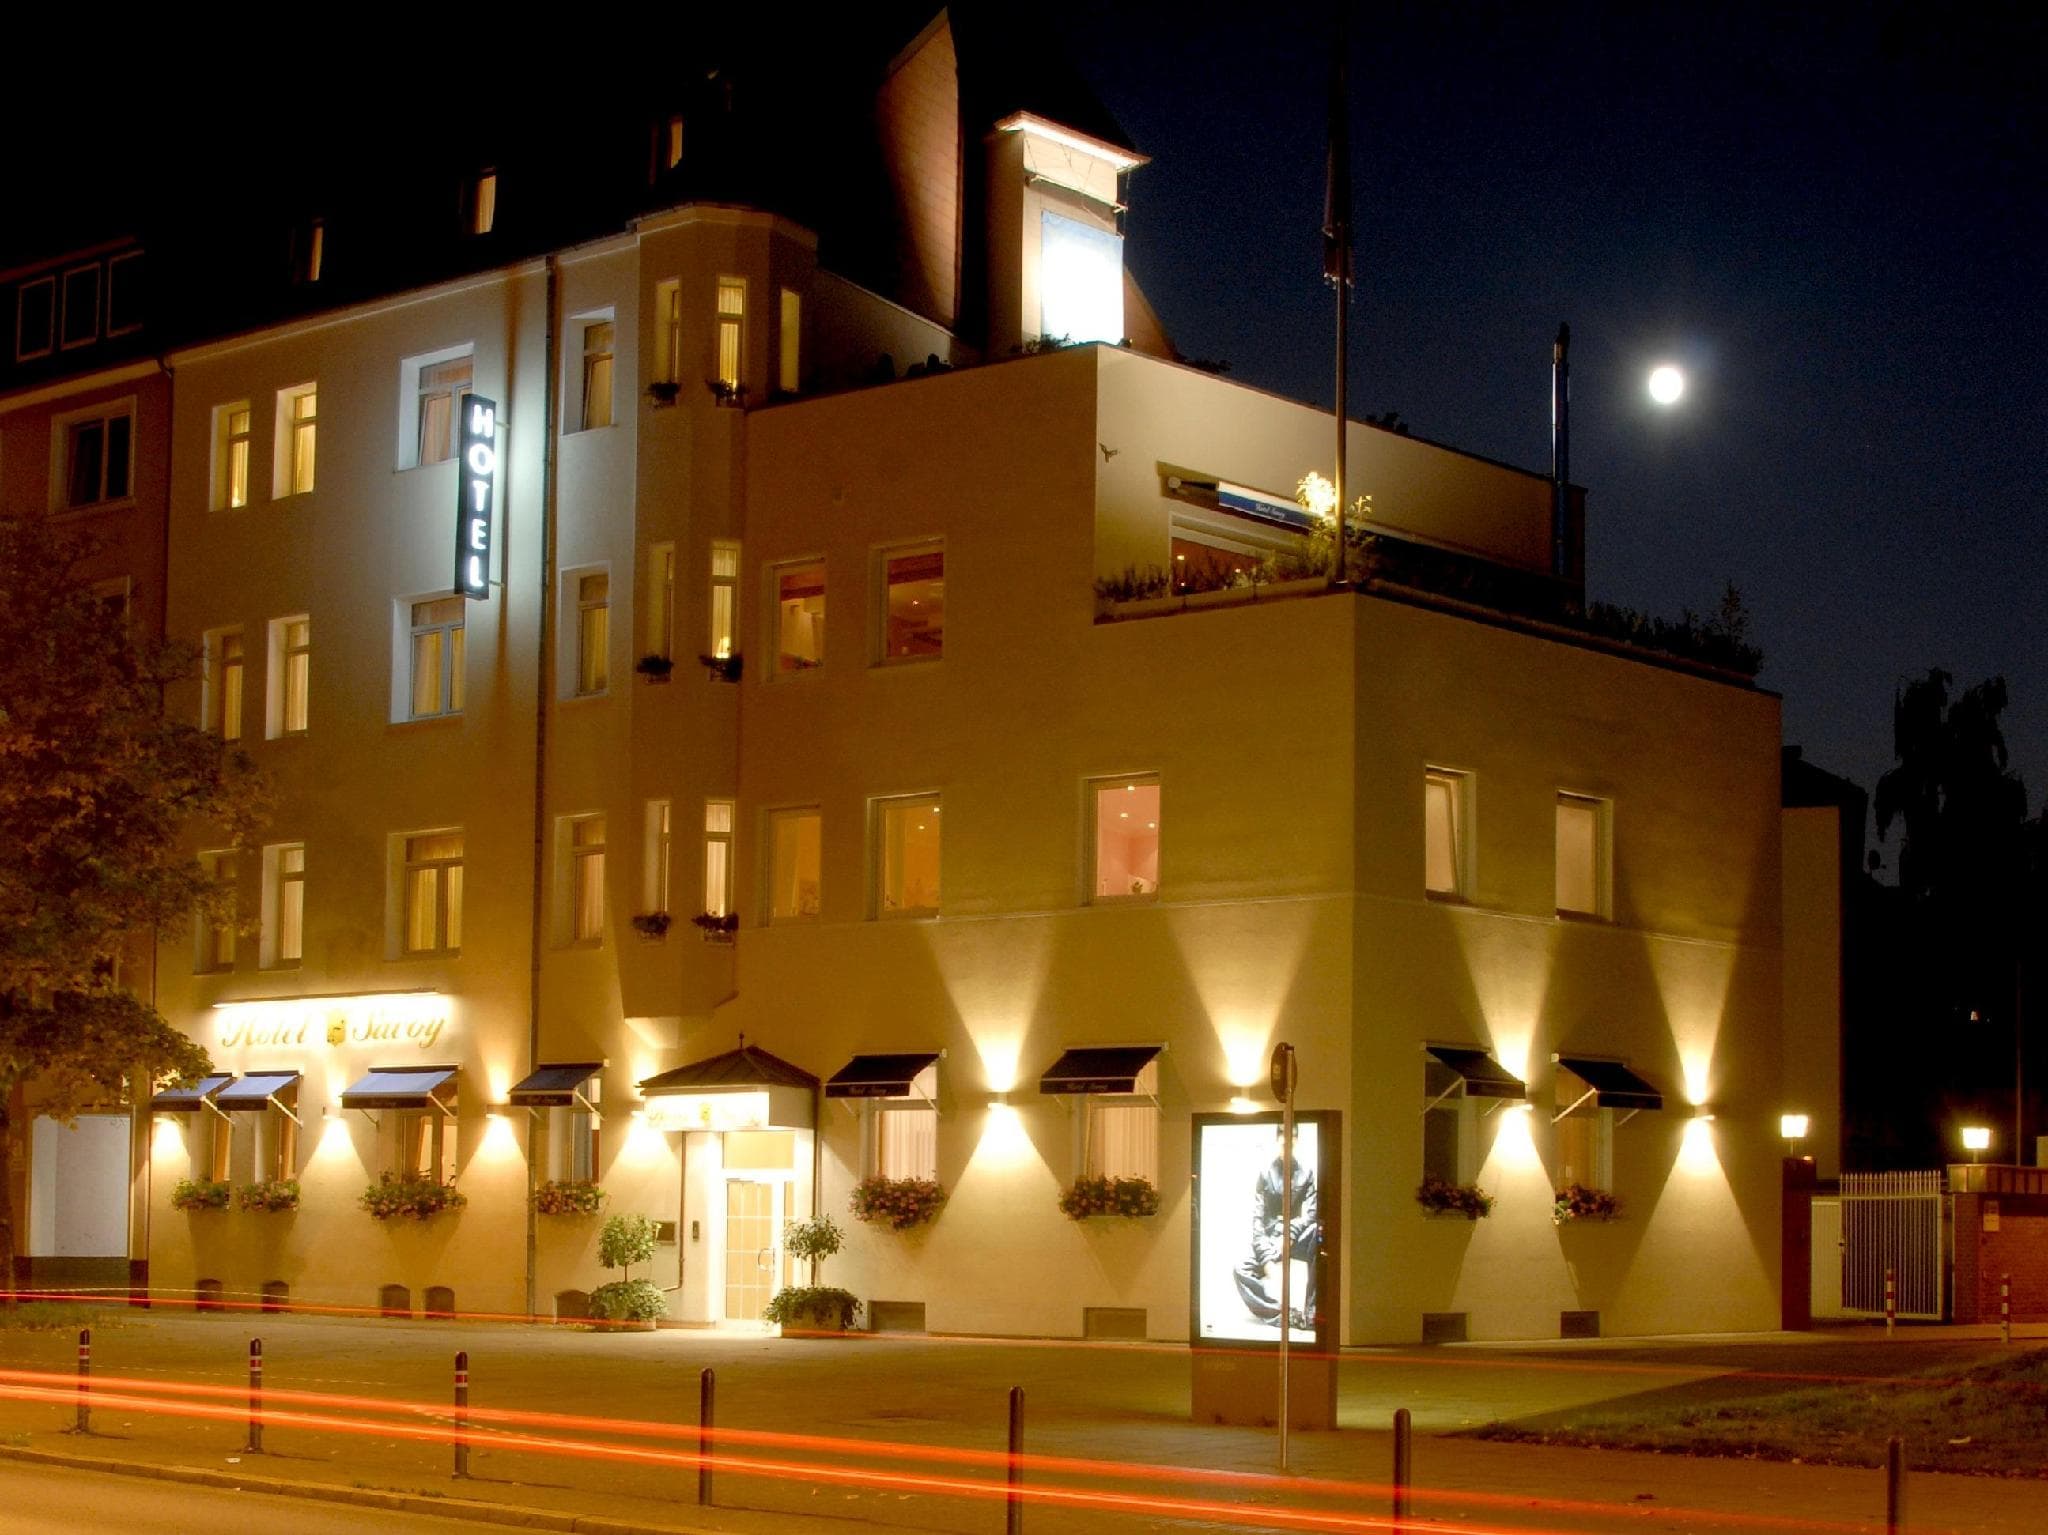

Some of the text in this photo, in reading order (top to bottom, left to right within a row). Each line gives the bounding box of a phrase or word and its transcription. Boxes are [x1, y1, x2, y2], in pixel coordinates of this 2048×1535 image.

[469, 404, 494, 588] HOTEL
[221, 1009, 445, 1048] Hotel Savoy
